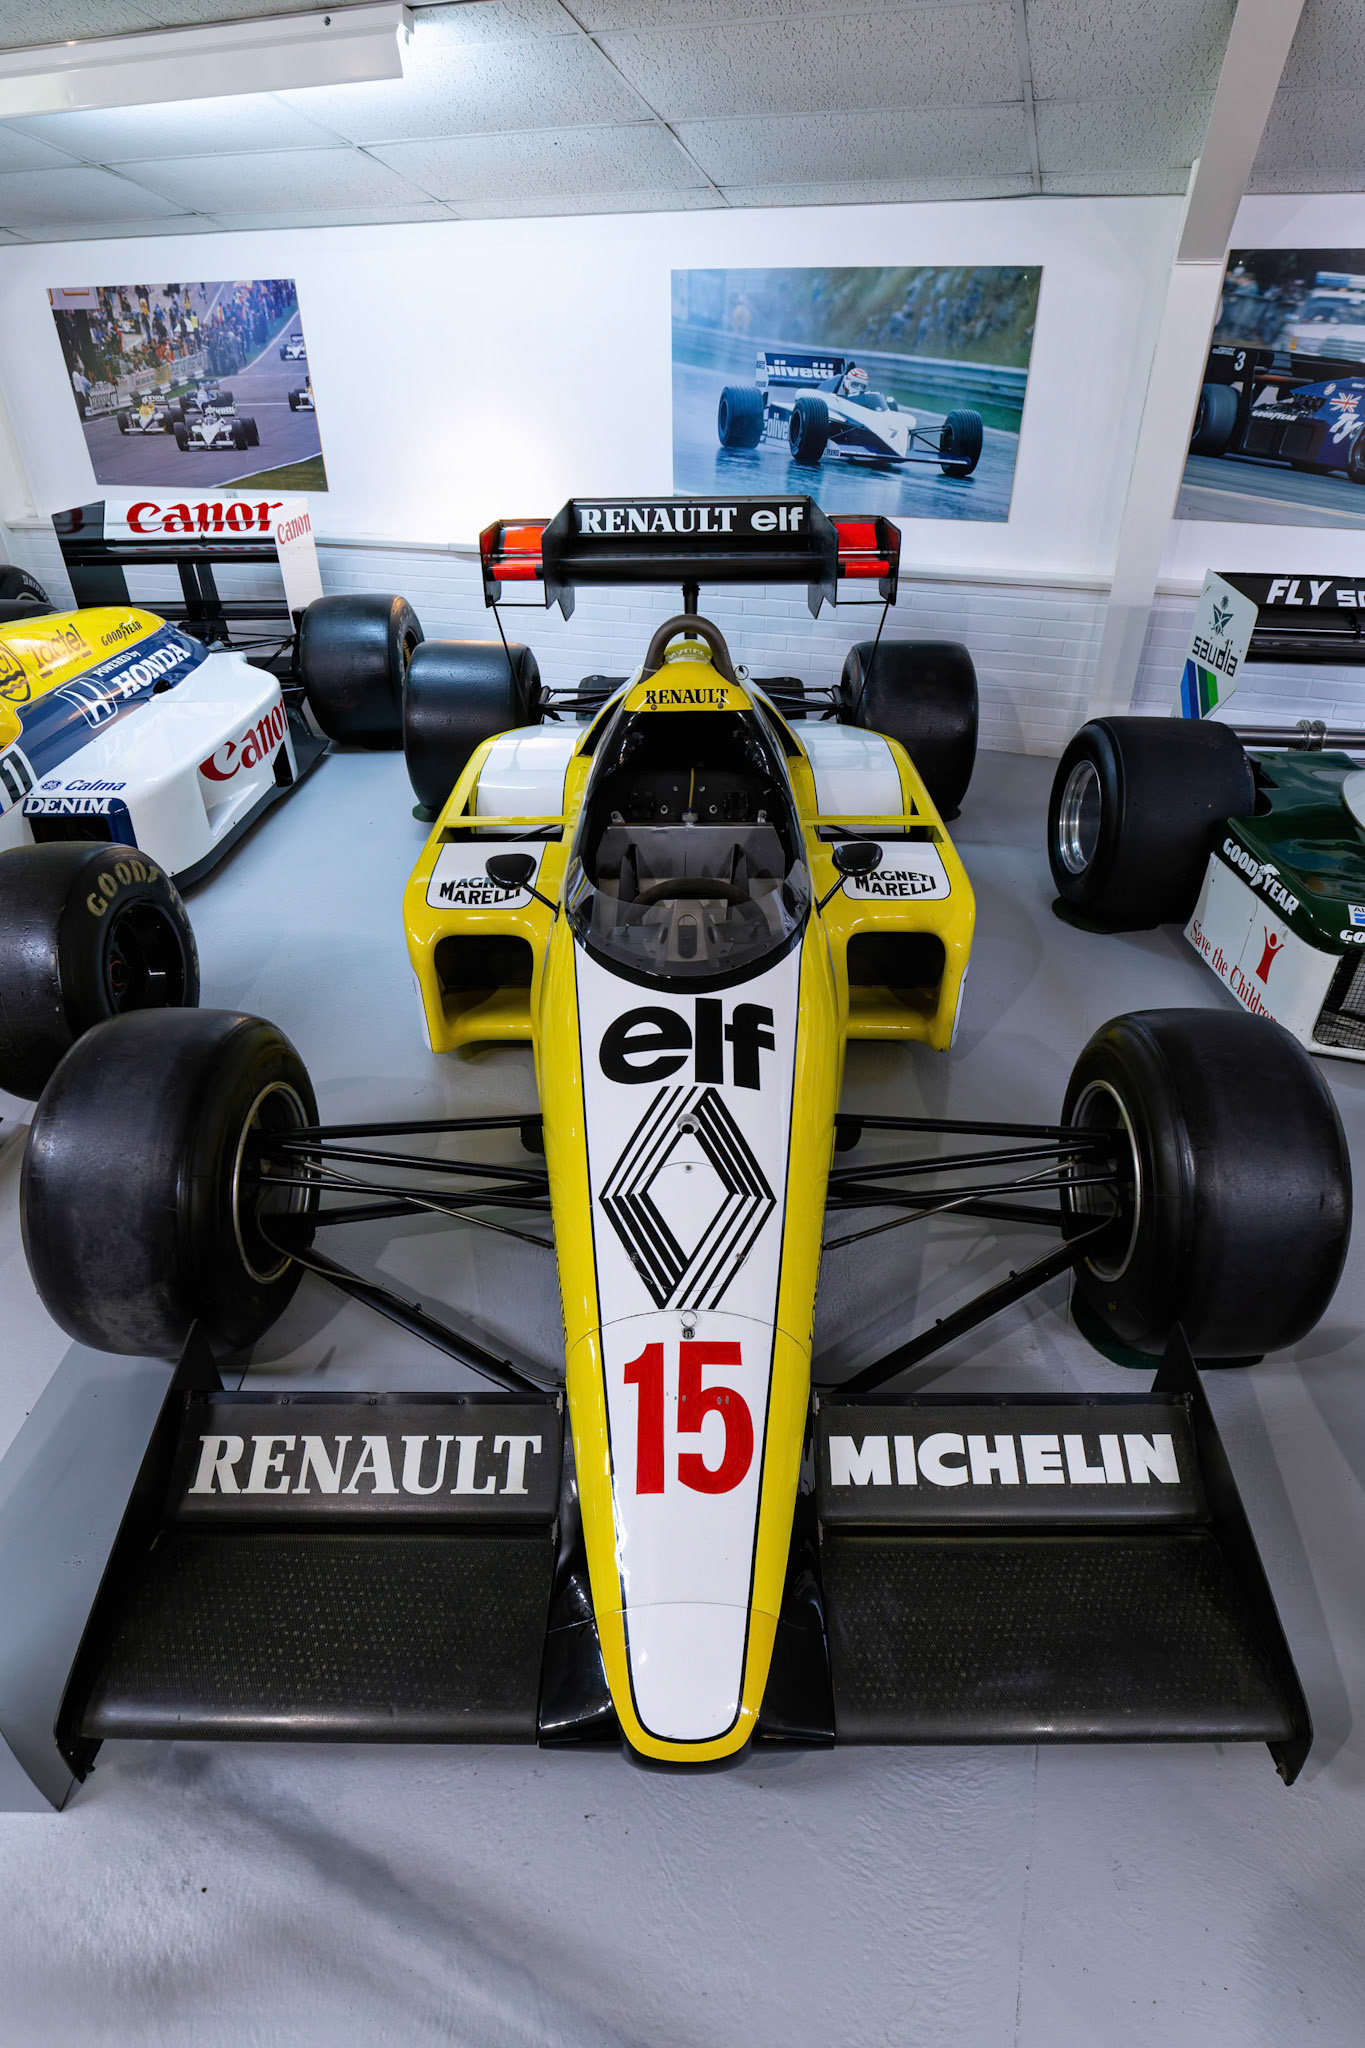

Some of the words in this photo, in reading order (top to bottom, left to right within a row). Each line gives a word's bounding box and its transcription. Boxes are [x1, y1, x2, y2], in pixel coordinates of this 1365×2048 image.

[1234, 351, 1246, 371] 3
[277, 513, 311, 545] Canon
[579, 507, 737, 534] RENAULT
[750, 506, 804, 531] elf
[1266, 579, 1333, 606] FLY
[101, 621, 143, 646] GOODYEAR
[92, 653, 131, 677] POWERED
[111, 643, 191, 699] HONDA
[1192, 636, 1239, 677] saudia
[645, 689, 729, 705] RENAULT
[65, 779, 126, 791] Calma
[24, 798, 112, 814] DENIM
[854, 880, 936, 896] MARELLI
[1223, 838, 1299, 916] GOODYEAR
[1191, 920, 1211, 956] Save
[1212, 947, 1228, 976] the
[1229, 966, 1276, 1022] Childre
[599, 998, 776, 1091] elf
[623, 1340, 754, 1495] 15
[188, 1435, 542, 1495] RENAULT
[828, 1432, 1181, 1487] MICHELIN
